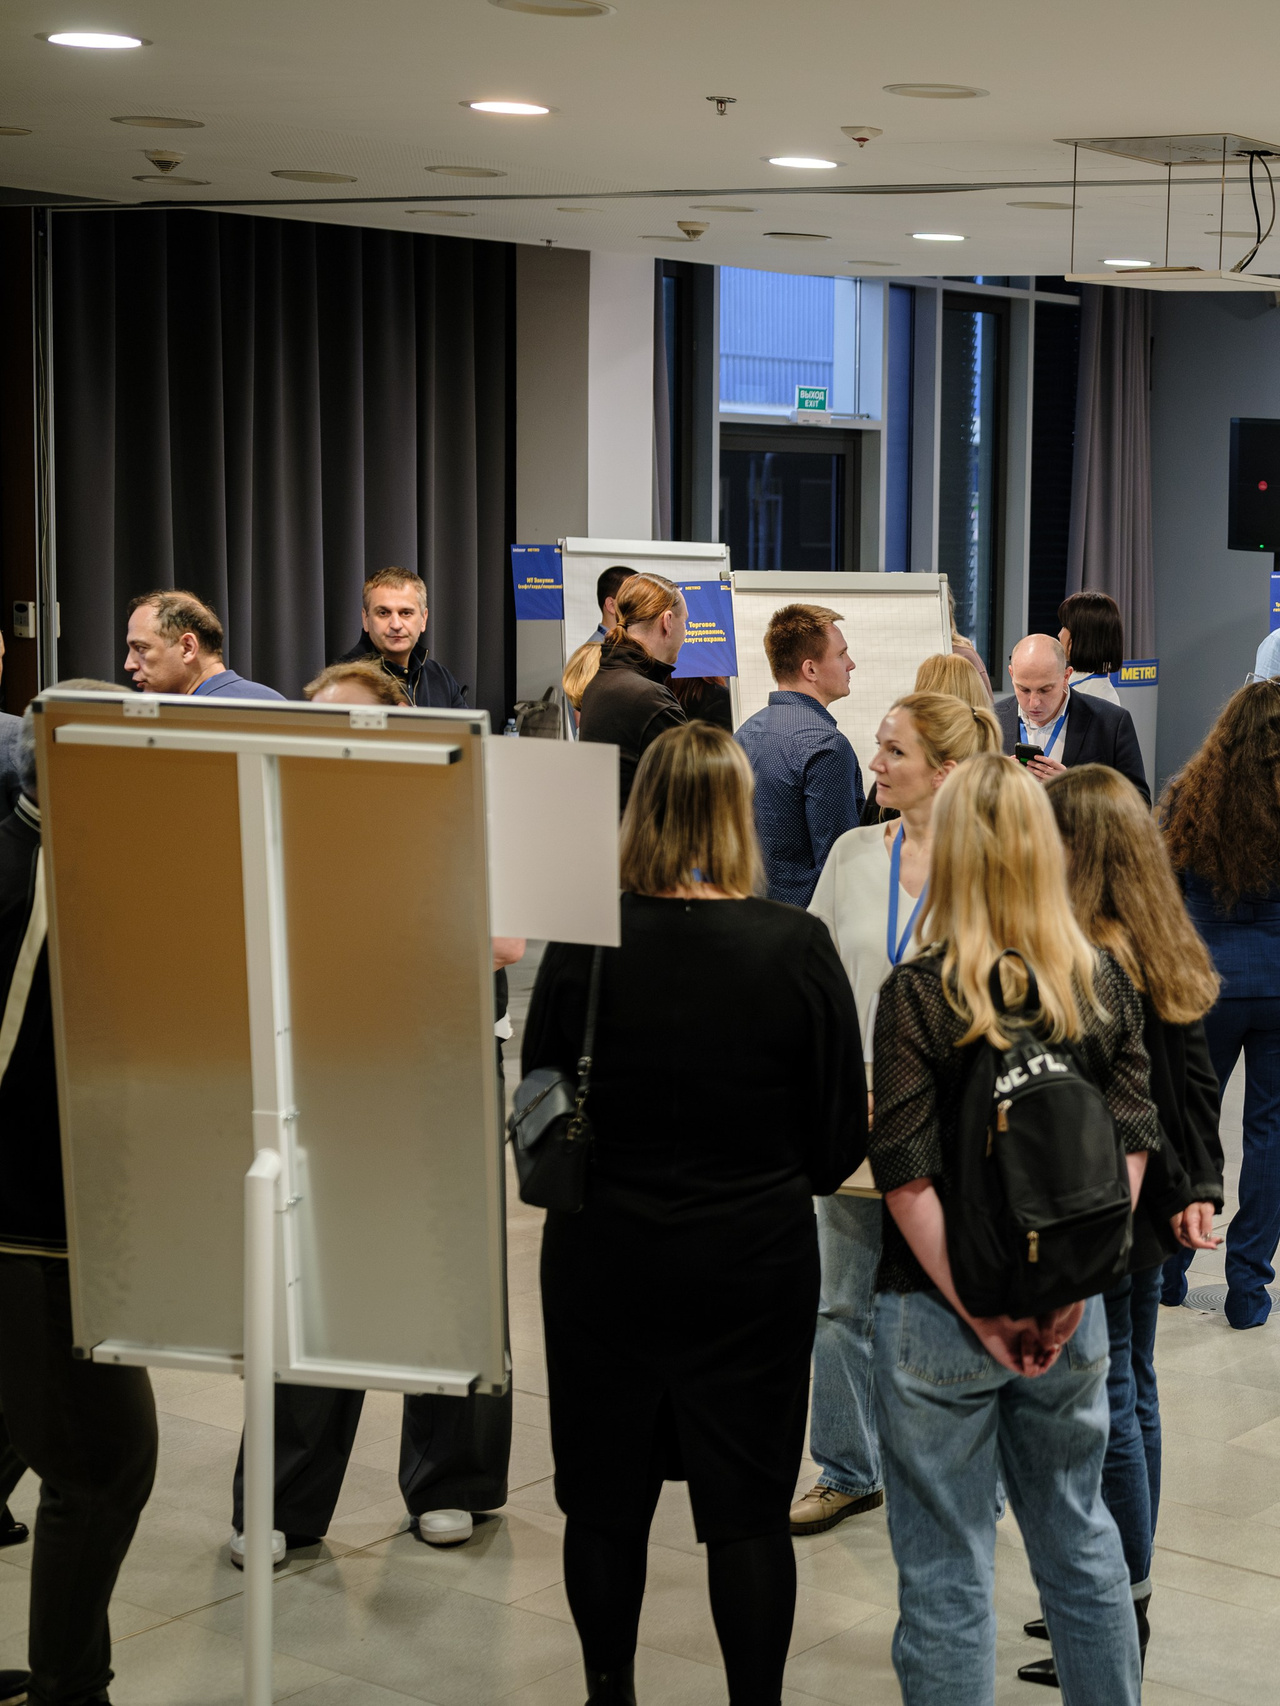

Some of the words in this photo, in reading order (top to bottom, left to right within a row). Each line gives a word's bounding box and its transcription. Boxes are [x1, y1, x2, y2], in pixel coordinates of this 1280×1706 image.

[800, 390, 824, 401] ВЫХОД
[805, 400, 818, 408] EXIT
[1121, 666, 1156, 681] METRO
